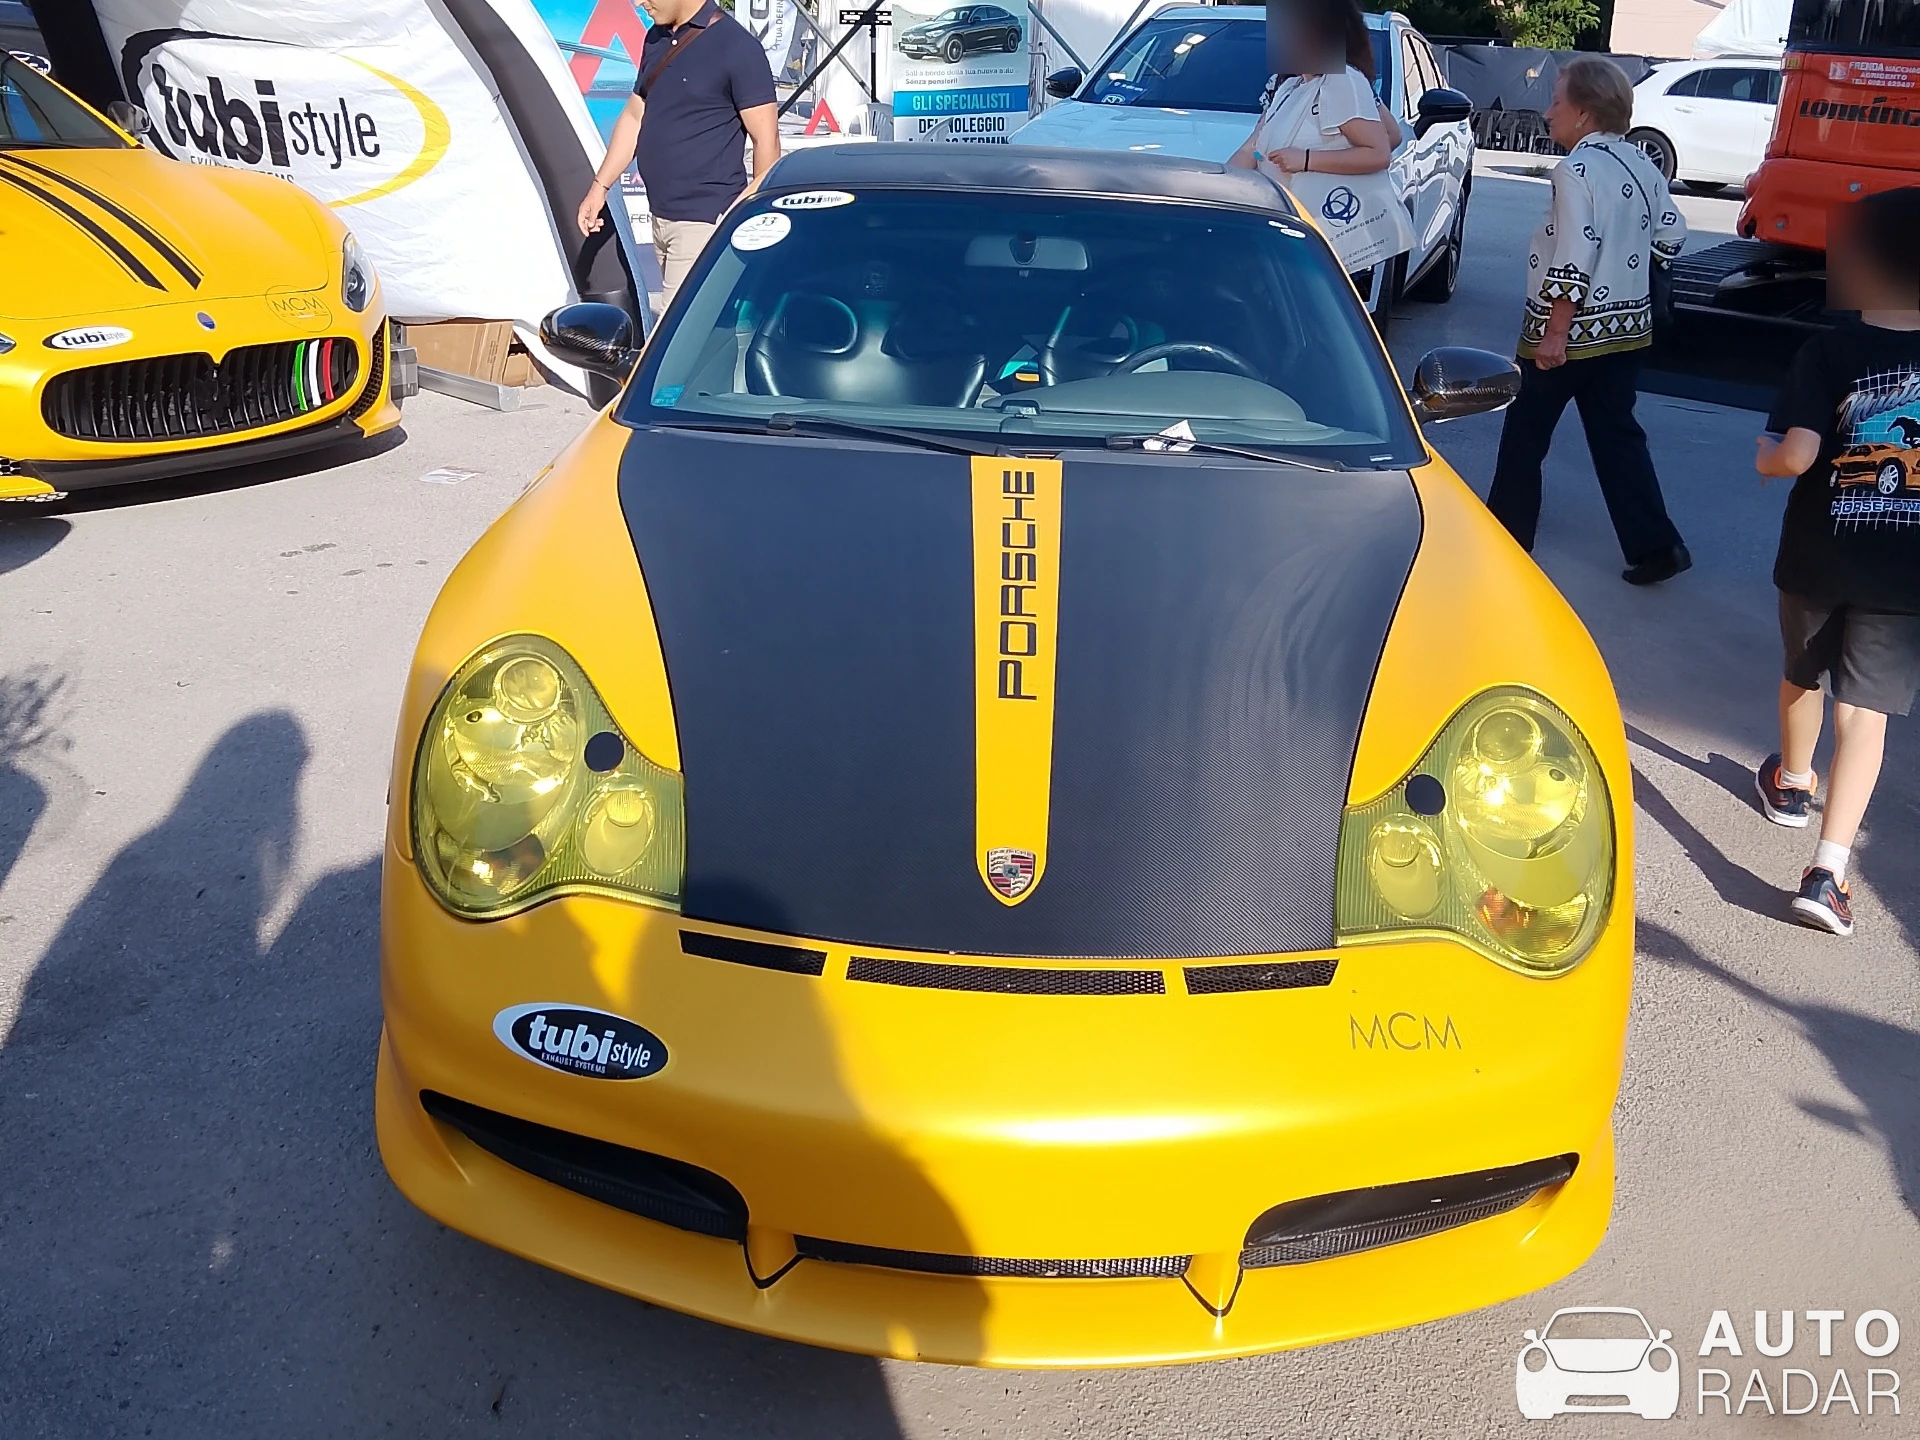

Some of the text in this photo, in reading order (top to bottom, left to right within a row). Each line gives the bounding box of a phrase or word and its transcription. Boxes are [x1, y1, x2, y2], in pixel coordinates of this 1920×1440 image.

[912, 92, 1010, 111] GLI SPECIALISTI
[152, 62, 381, 170] tubi style
[781, 195, 823, 206] tubi
[272, 296, 323, 312] MCM
[61, 331, 107, 346] tubi
[998, 469, 1038, 701] PORSCHE
[528, 1014, 651, 1070] tubi style
[1349, 1012, 1462, 1051] MCM
[541, 1052, 606, 1075] EXHAUST SYSTEMS
